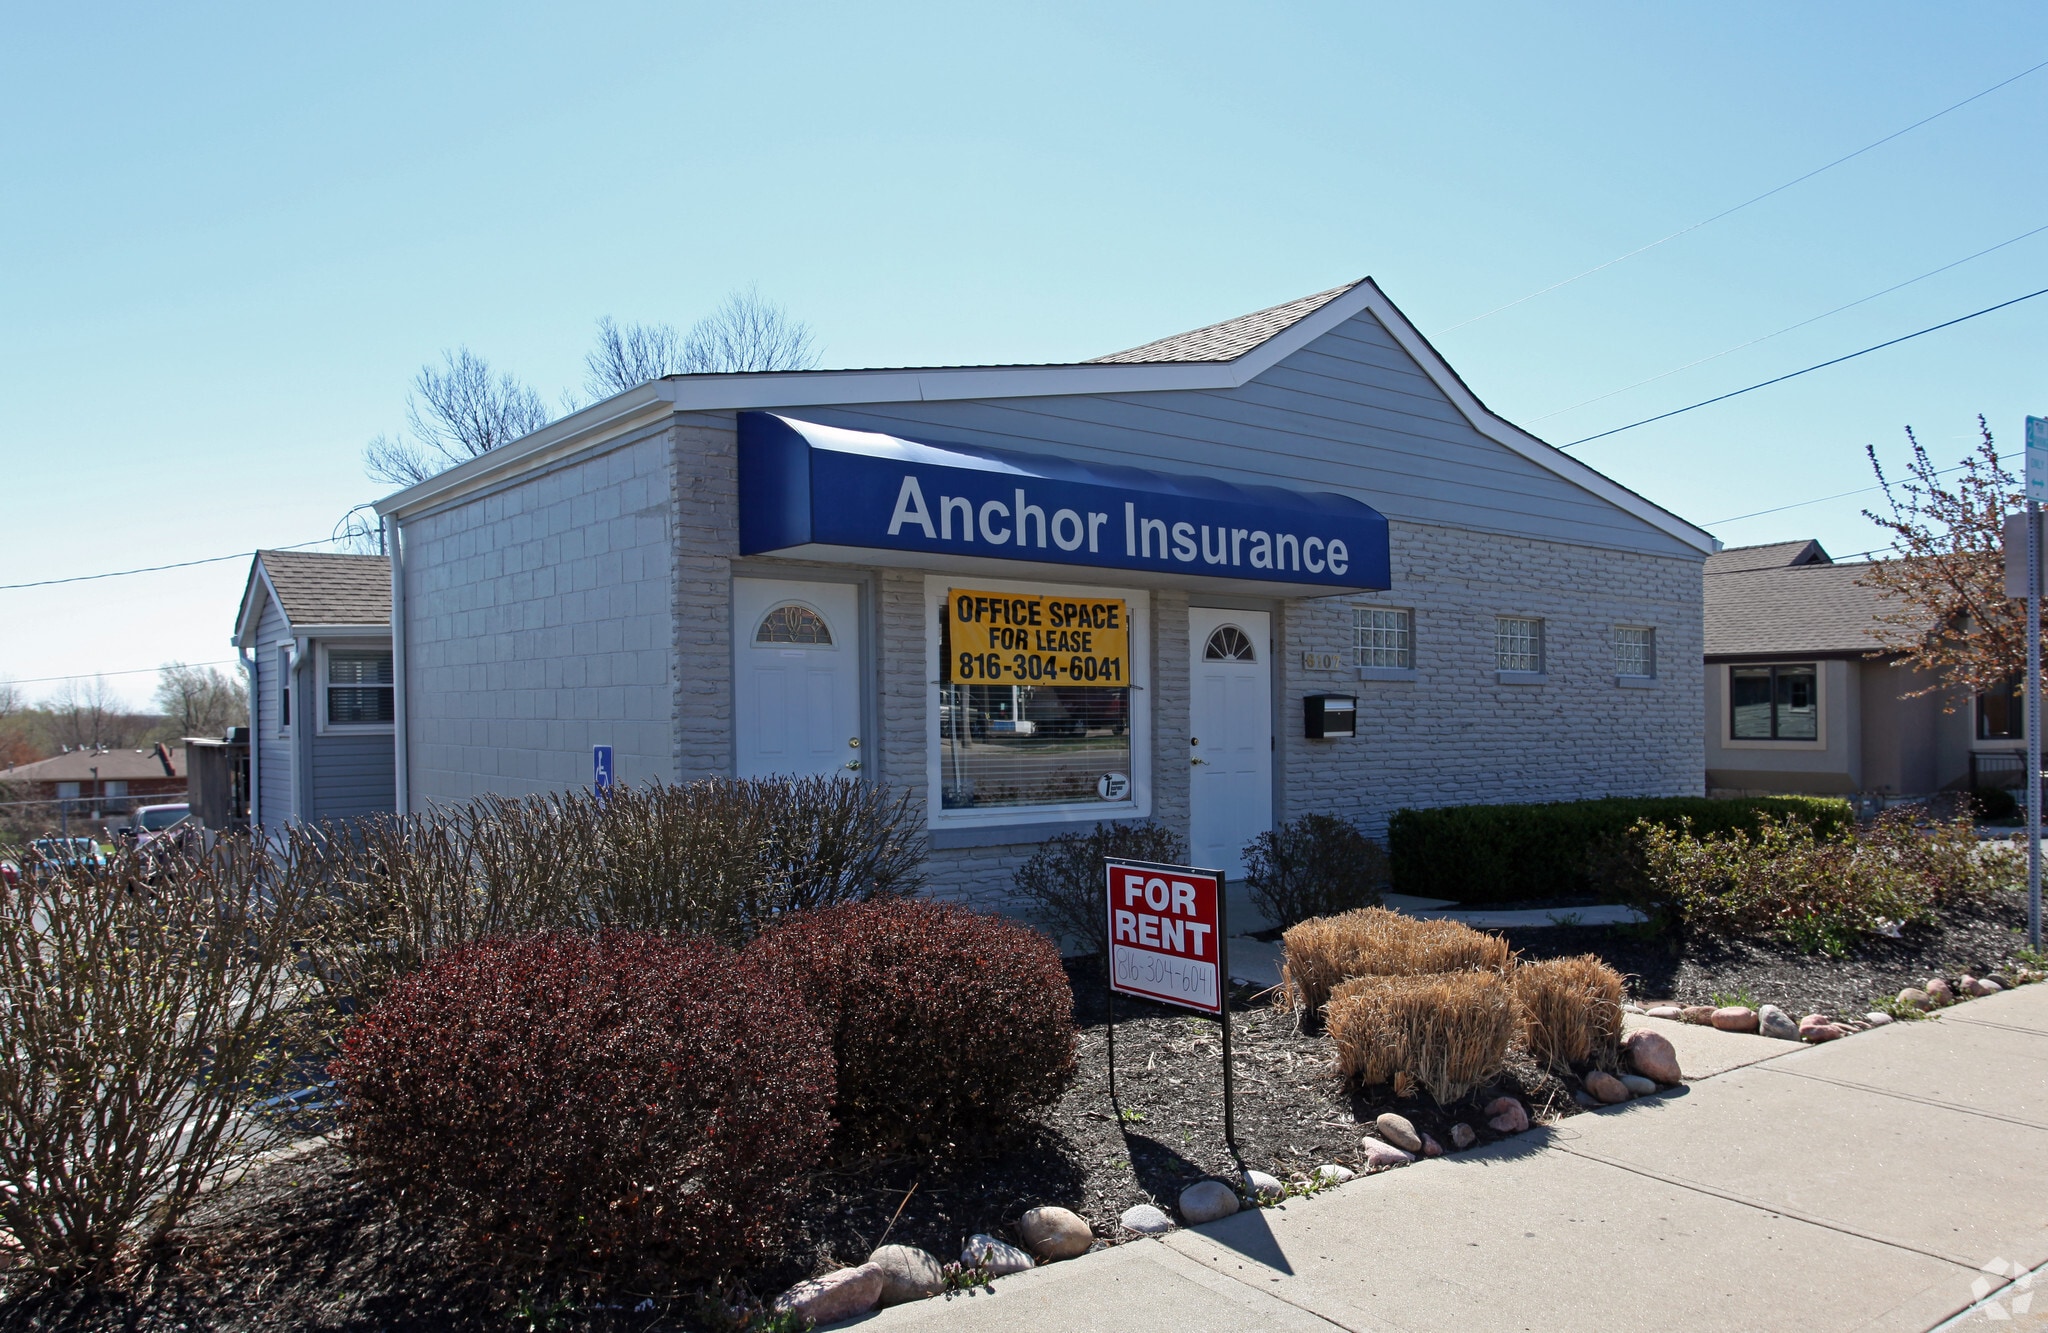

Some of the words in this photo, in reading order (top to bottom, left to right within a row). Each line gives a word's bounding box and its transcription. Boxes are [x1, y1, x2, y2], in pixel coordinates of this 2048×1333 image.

[887, 475, 1108, 553] Anchor
[1124, 501, 1349, 576] Insurance
[957, 595, 1042, 626] OFFICE
[1049, 601, 1119, 630] SPACE
[989, 627, 1028, 651] FOR
[1036, 629, 1092, 653] LEASE
[959, 652, 1121, 681] 816-304-6041
[1124, 874, 1196, 917] FOR
[1115, 908, 1211, 956] RENT
[1115, 947, 1212, 997] 816-304-6041
